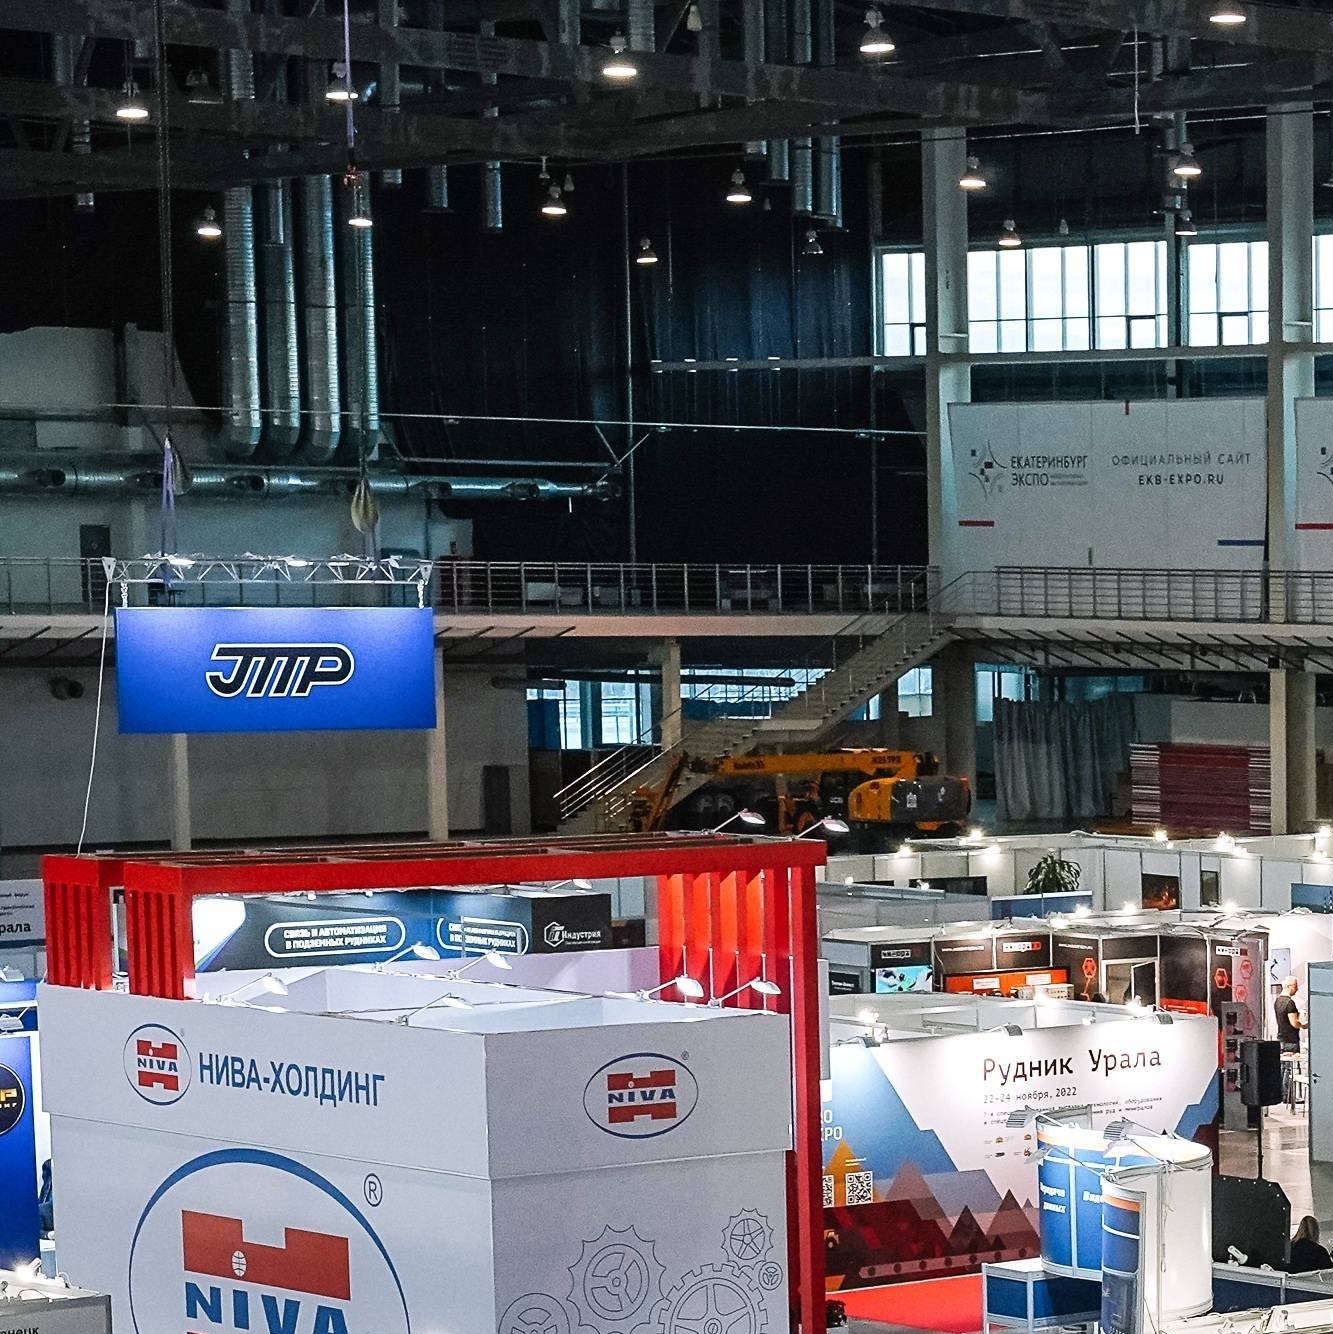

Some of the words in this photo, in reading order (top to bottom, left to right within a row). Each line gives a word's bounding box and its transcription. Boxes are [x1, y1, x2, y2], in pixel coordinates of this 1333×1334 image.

[1011, 456, 1087, 469] ЕКАТЕРИНБУРГ
[1112, 452, 1211, 466] ОФИЦИАЛЬНЫЙ
[1218, 452, 1250, 464] САЙТ
[1011, 473, 1048, 485] ЭКСПО
[1139, 474, 1223, 485] EKB-EXPO.RU
[138, 1058, 178, 1072] NIVA
[983, 1056, 1073, 1086] Рудник
[1089, 1048, 1162, 1077] Урала
[200, 1052, 385, 1106] НИВА-ХОЛДИНГ
[607, 1085, 677, 1106] NIVA
[1056, 1087, 1077, 1098] 2022
